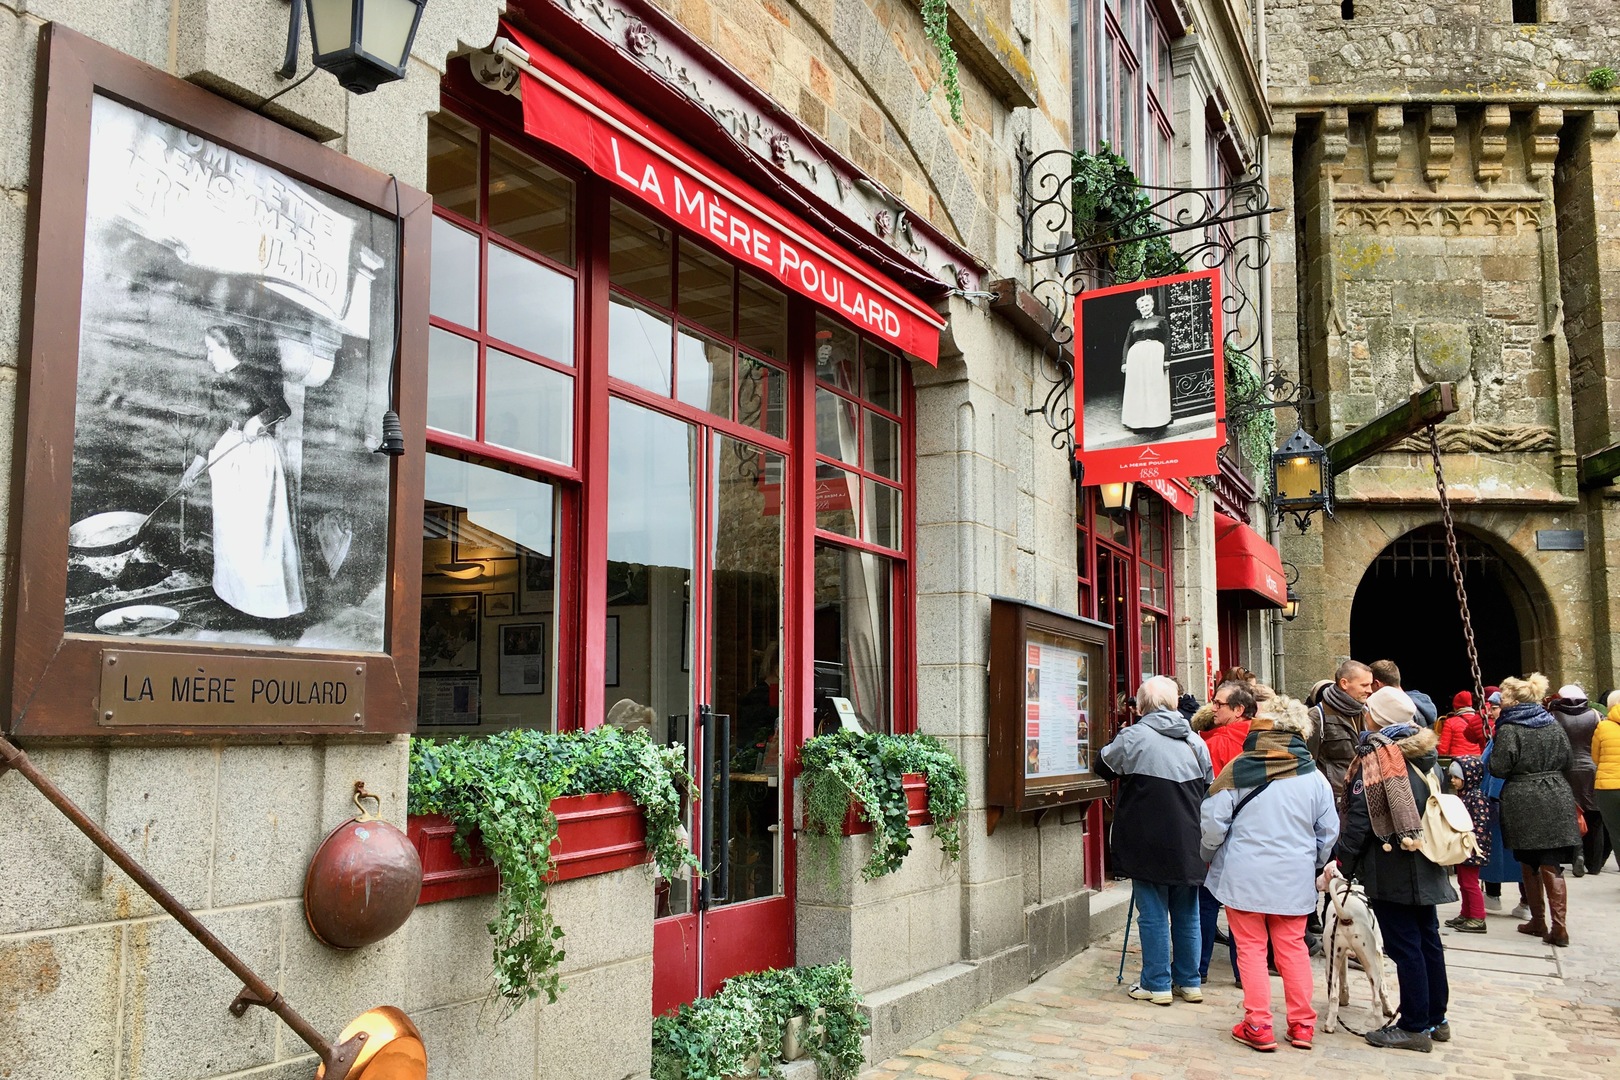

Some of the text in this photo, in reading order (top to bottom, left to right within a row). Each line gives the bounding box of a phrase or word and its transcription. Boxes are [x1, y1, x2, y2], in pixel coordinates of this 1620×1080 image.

[611, 137, 901, 338] LA MÈRE POULARD
[1139, 468, 1159, 478] 1888
[123, 667, 348, 705] LA MÈRE POULARD
